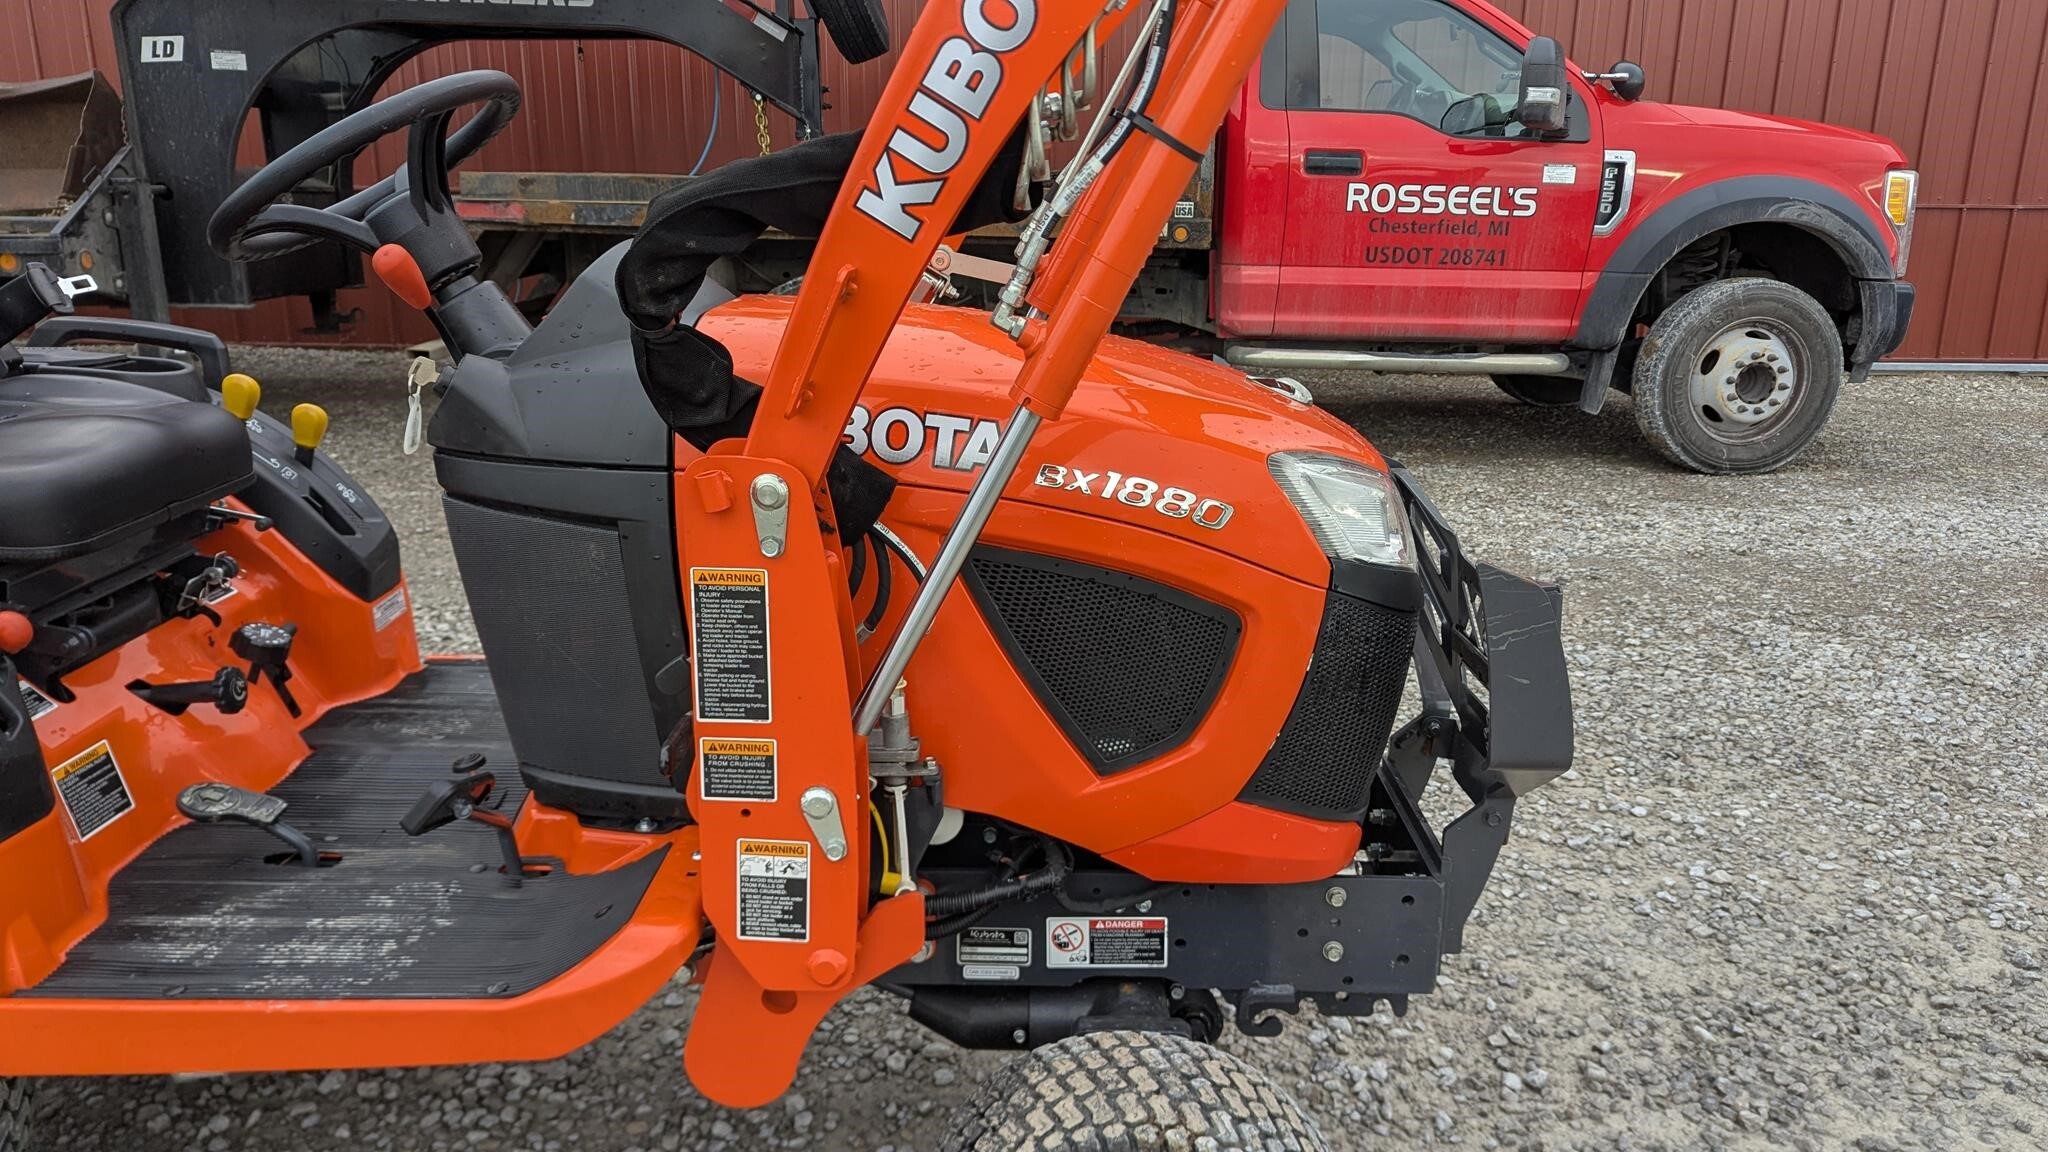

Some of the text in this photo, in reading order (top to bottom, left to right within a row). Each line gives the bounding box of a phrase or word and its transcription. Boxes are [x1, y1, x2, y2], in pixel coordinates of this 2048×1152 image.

[152, 40, 175, 58] LD
[1346, 183, 1538, 216] ROSSEEL'S
[1176, 207, 1193, 216] USA
[1368, 218, 1510, 237] Chesterfield, MI
[1365, 247, 1507, 266] USDOT 208741
[1034, 463, 1233, 530] BX1880
[708, 572, 761, 582] WARNING
[718, 744, 769, 753] WARNING
[753, 844, 804, 854] WARNING
[971, 930, 1005, 939] Kubota
